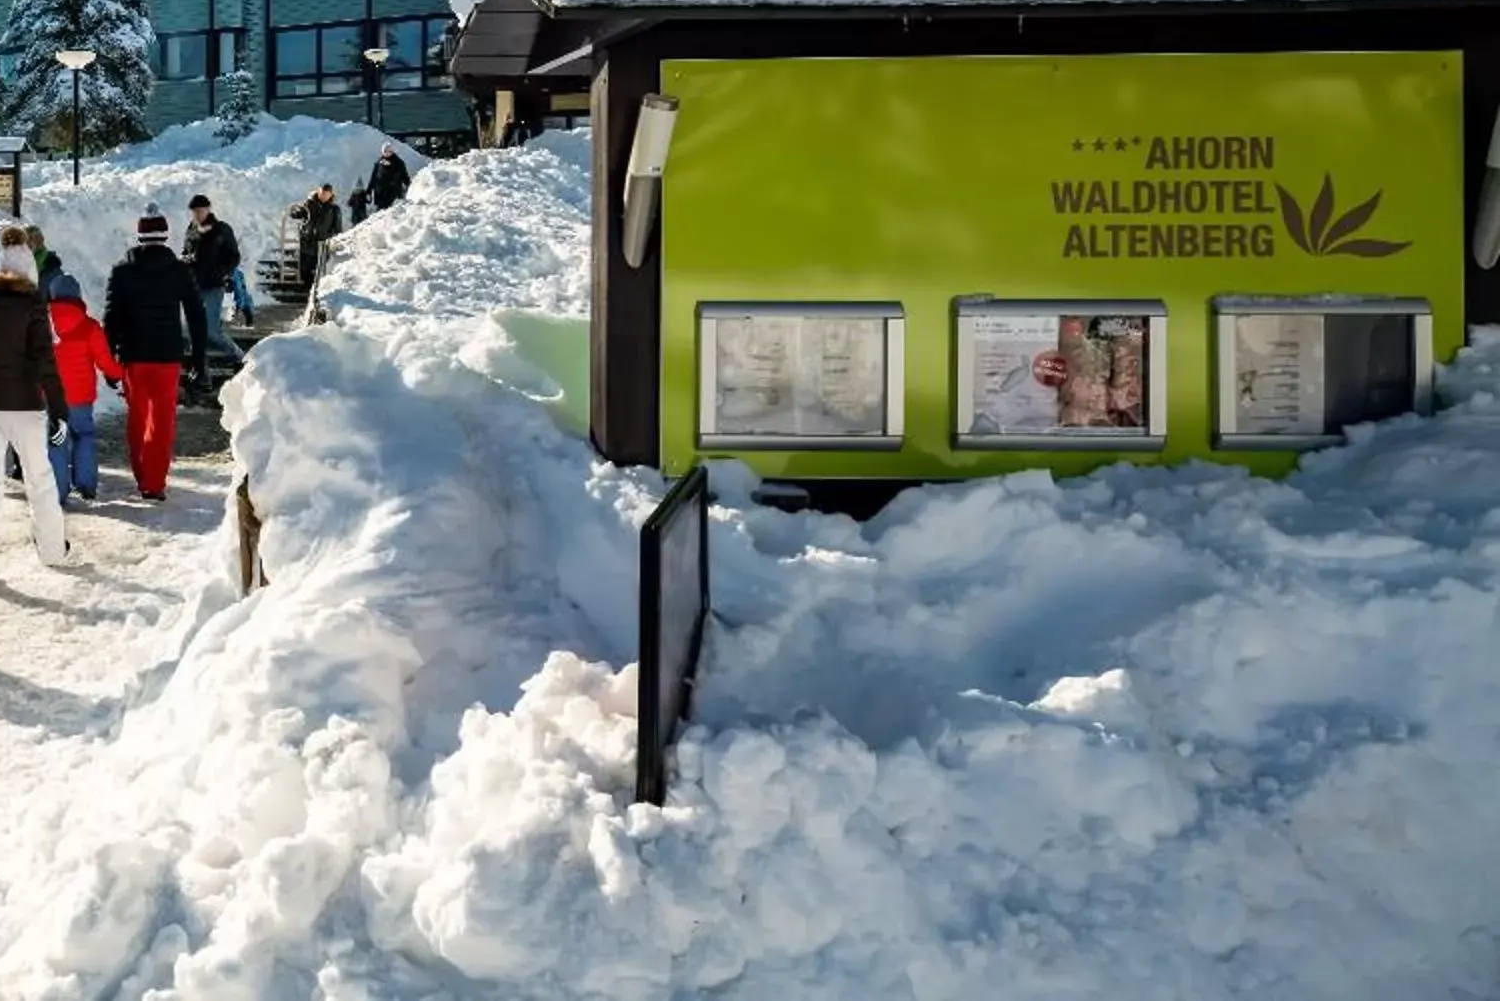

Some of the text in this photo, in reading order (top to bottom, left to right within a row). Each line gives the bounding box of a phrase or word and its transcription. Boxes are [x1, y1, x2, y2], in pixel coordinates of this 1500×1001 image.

[1145, 136, 1275, 170] AHORN
[1051, 180, 1275, 215] WALDHOTEL
[1062, 223, 1275, 259] ALTENBERG
